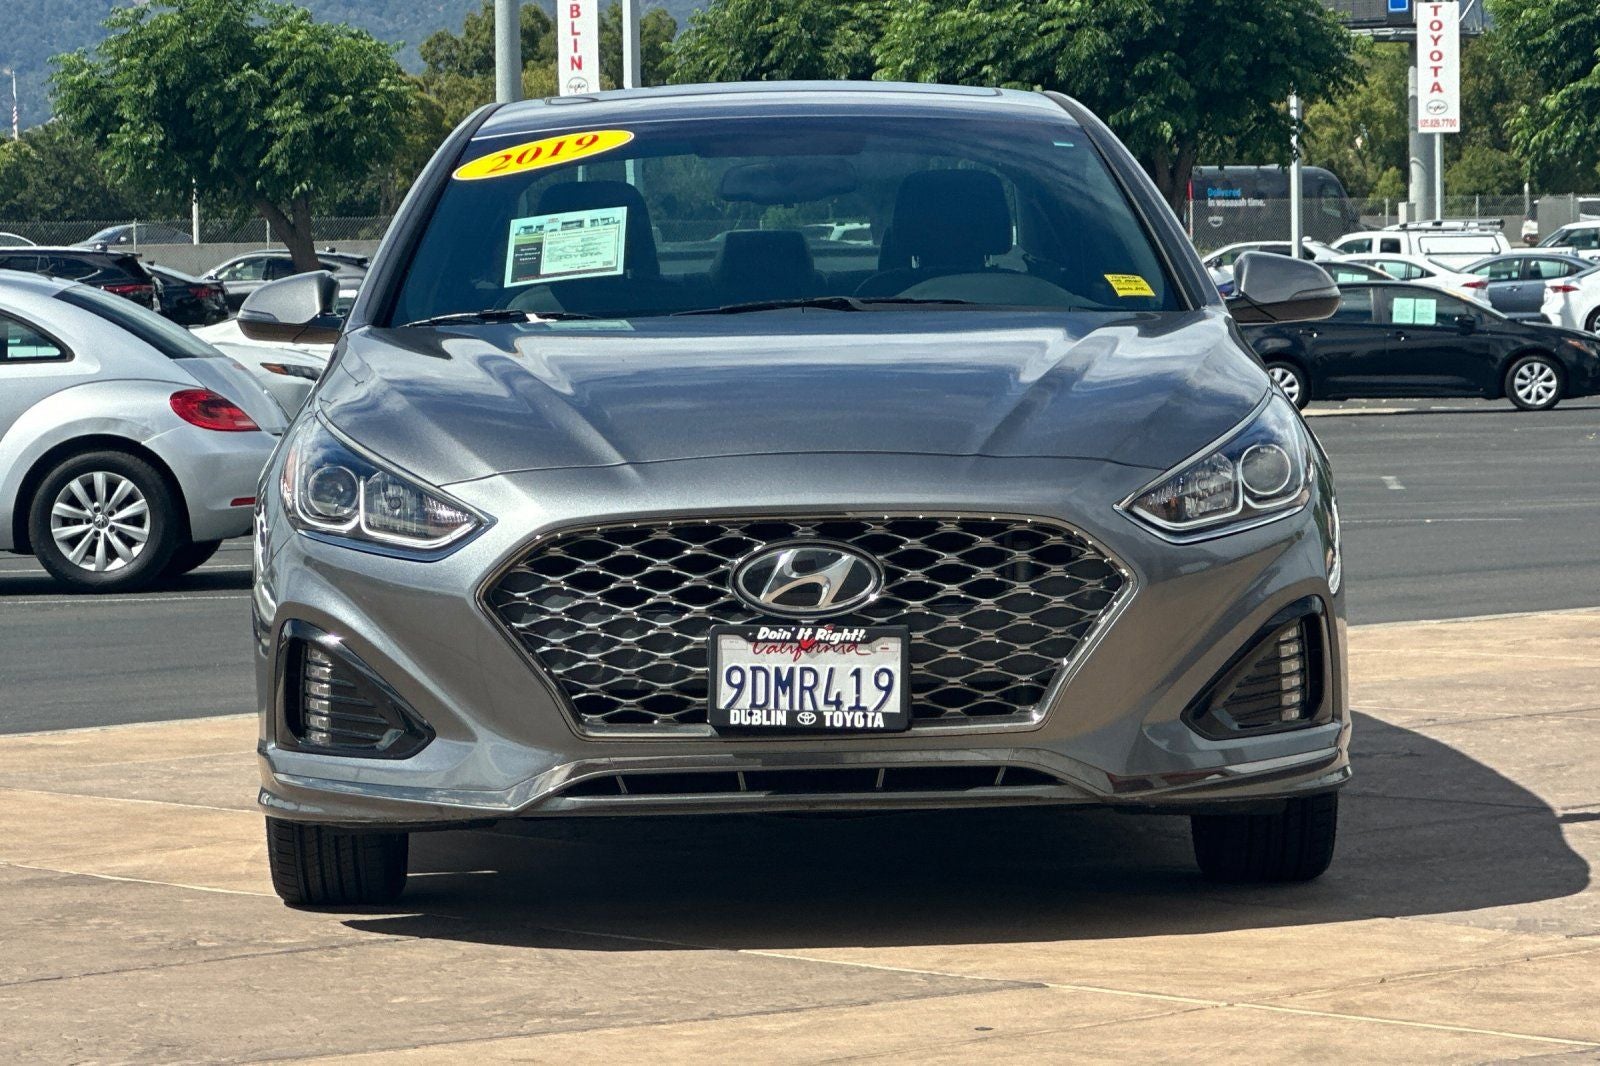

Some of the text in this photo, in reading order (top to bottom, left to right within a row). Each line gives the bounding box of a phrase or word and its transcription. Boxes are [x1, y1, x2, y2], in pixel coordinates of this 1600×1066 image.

[570, 0, 582, 71] BLIN
[1429, 5, 1444, 94] TOYOTA
[486, 134, 600, 174] 2019
[1207, 187, 1242, 197] Delivered
[756, 627, 867, 645] Doin' It Right!
[724, 665, 895, 711] 9DMR419
[729, 709, 885, 728] DUBLIN TOYOTA
